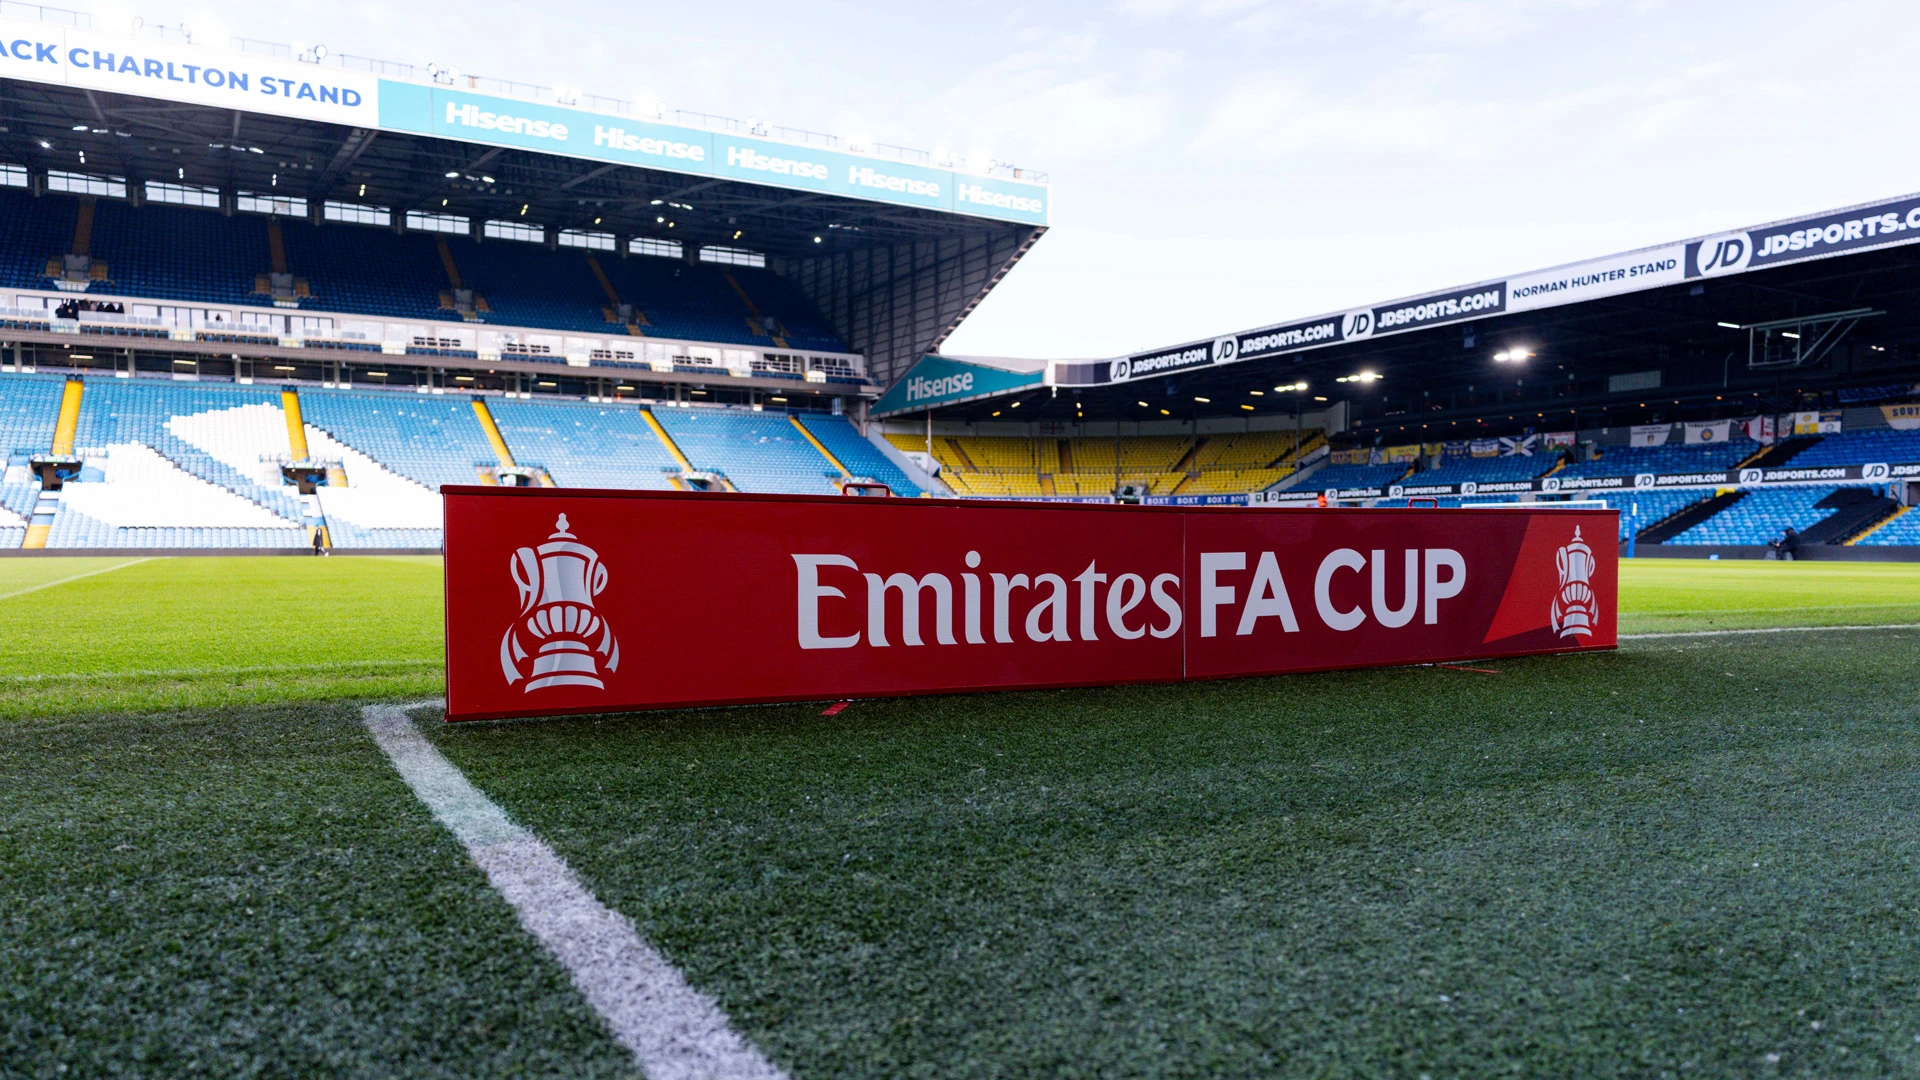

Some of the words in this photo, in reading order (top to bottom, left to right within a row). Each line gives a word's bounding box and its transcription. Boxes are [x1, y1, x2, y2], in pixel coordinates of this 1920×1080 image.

[68, 47, 250, 91] CHARLTON
[260, 76, 362, 107] STAND
[446, 101, 568, 141] Hisense
[594, 125, 705, 162] Hisense
[727, 146, 829, 181] Hisense
[848, 165, 940, 199] Hisense
[959, 183, 1043, 214] Hisense
[1704, 238, 1745, 272] JD
[1512, 280, 1568, 300] NORMAN
[1571, 268, 1626, 287] HUNTER
[1630, 258, 1677, 276] STAND
[1347, 312, 1370, 339] JD
[1377, 290, 1500, 329] JDSPORTS.COM
[1216, 339, 1235, 361] JD
[1239, 322, 1335, 354] JDSPORTS.COM
[1113, 361, 1128, 378] JD
[1131, 347, 1207, 373] JDSPORTS.COM
[906, 372, 974, 402] Hisense
[1477, 482, 1532, 493] JDSPORTS.COM
[1656, 473, 1727, 485] JDSPORTS.COM
[1743, 469, 1760, 482] JD
[1764, 468, 1846, 481] JDSPORTS.COM
[1866, 465, 1885, 477] JD
[1207, 496, 1227, 504] BOXT
[791, 549, 1183, 650] Emirates
[1200, 551, 1300, 638] FA
[1314, 547, 1467, 632] CUP
